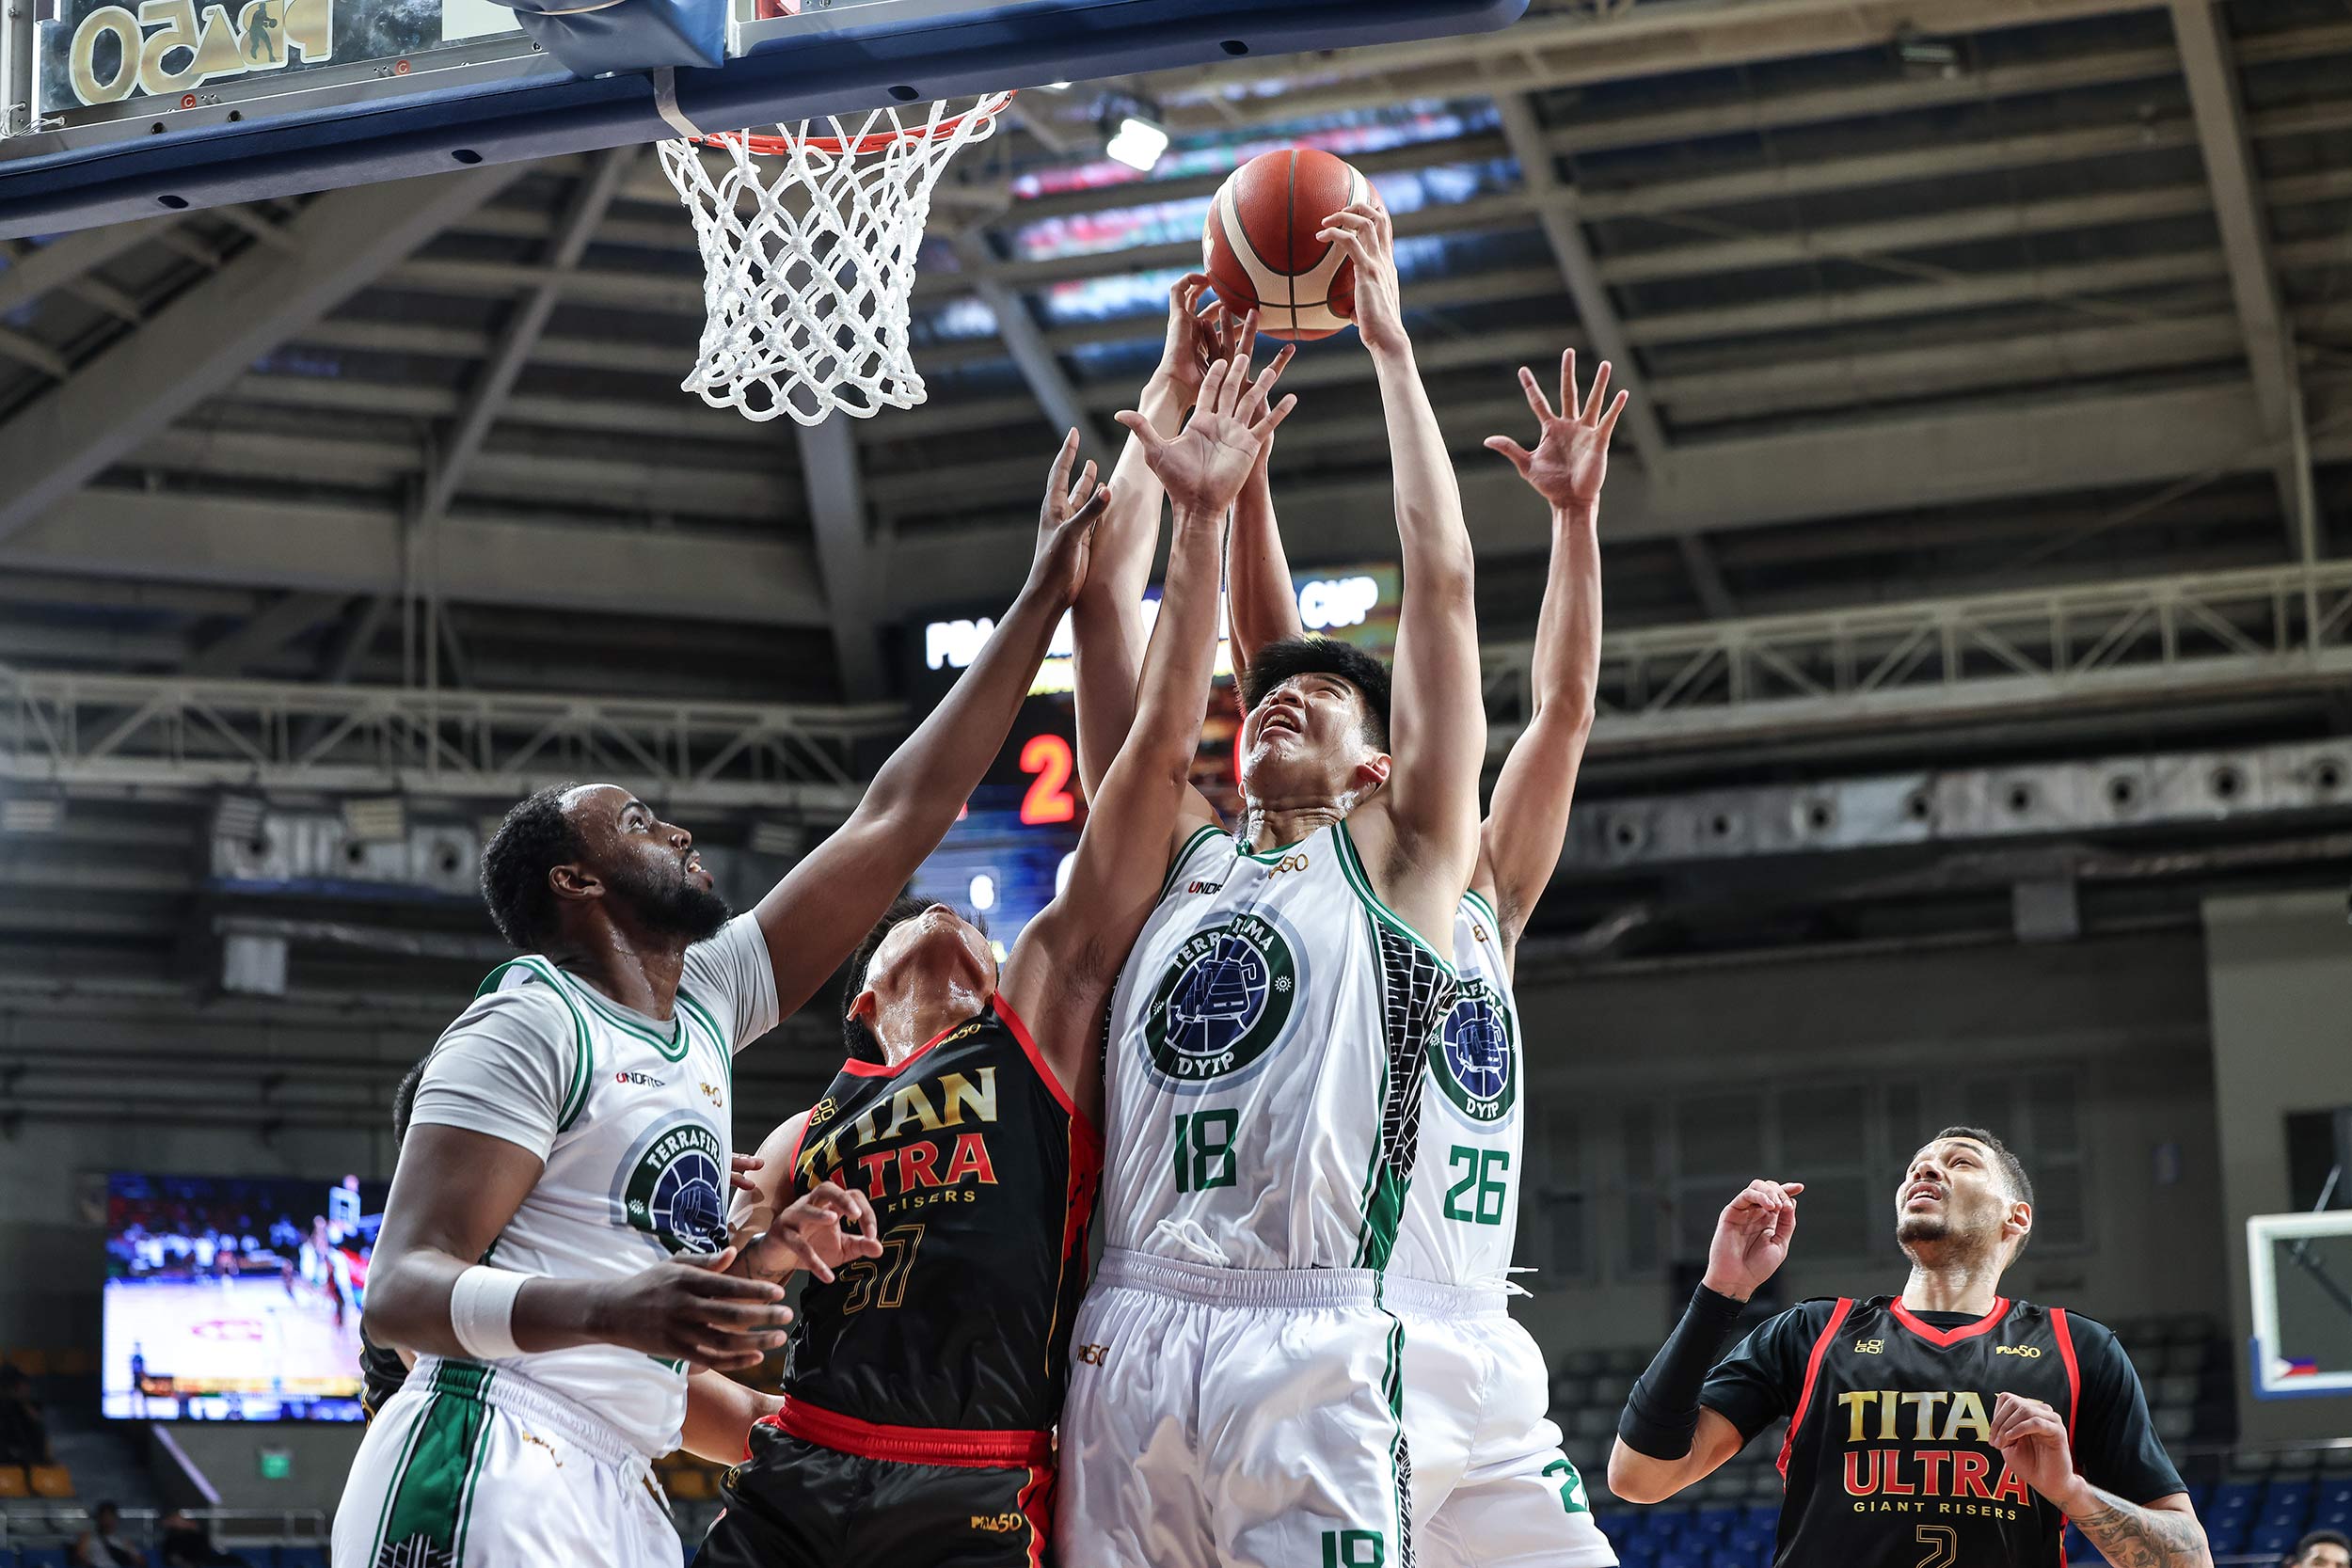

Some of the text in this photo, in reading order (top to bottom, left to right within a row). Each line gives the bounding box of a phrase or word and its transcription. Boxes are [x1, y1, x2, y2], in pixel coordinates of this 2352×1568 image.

[1298, 576, 1378, 628] CUP
[1020, 733, 1074, 825] 2
[1177, 1052, 1234, 1076] DYIP
[1465, 1097, 1499, 1119] DYIP
[646, 1129, 723, 1170] TERRAFIR
[829, 1132, 998, 1200] TRA
[1173, 1108, 1239, 1194] 18
[1443, 1144, 1510, 1226] 26
[1838, 1390, 2043, 1442] TITA
[1542, 1459, 1589, 1513] 2
[1843, 1449, 2030, 1506] ULTRA
[1853, 1501, 2016, 1520] GIANT RISERS
